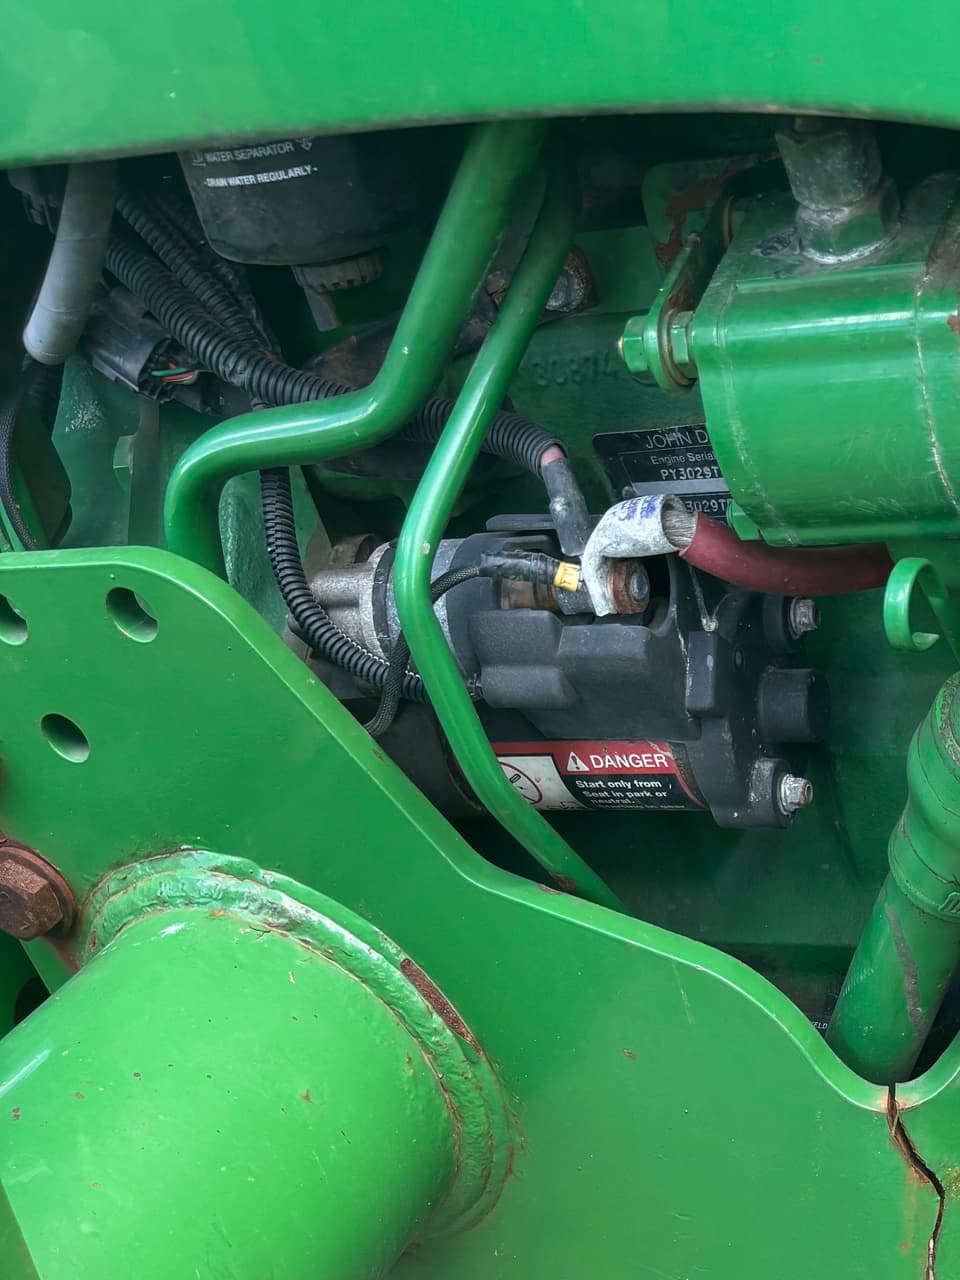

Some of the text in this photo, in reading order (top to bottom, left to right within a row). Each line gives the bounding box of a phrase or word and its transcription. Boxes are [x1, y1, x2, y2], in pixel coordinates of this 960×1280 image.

[204, 141, 295, 163] WATER SEPARATOR
[228, 174, 257, 187] WATER
[646, 431, 693, 449] JOHN
[650, 451, 716, 466] Engine Seria
[589, 752, 669, 769] DANGER
[575, 779, 662, 790] Start only from
